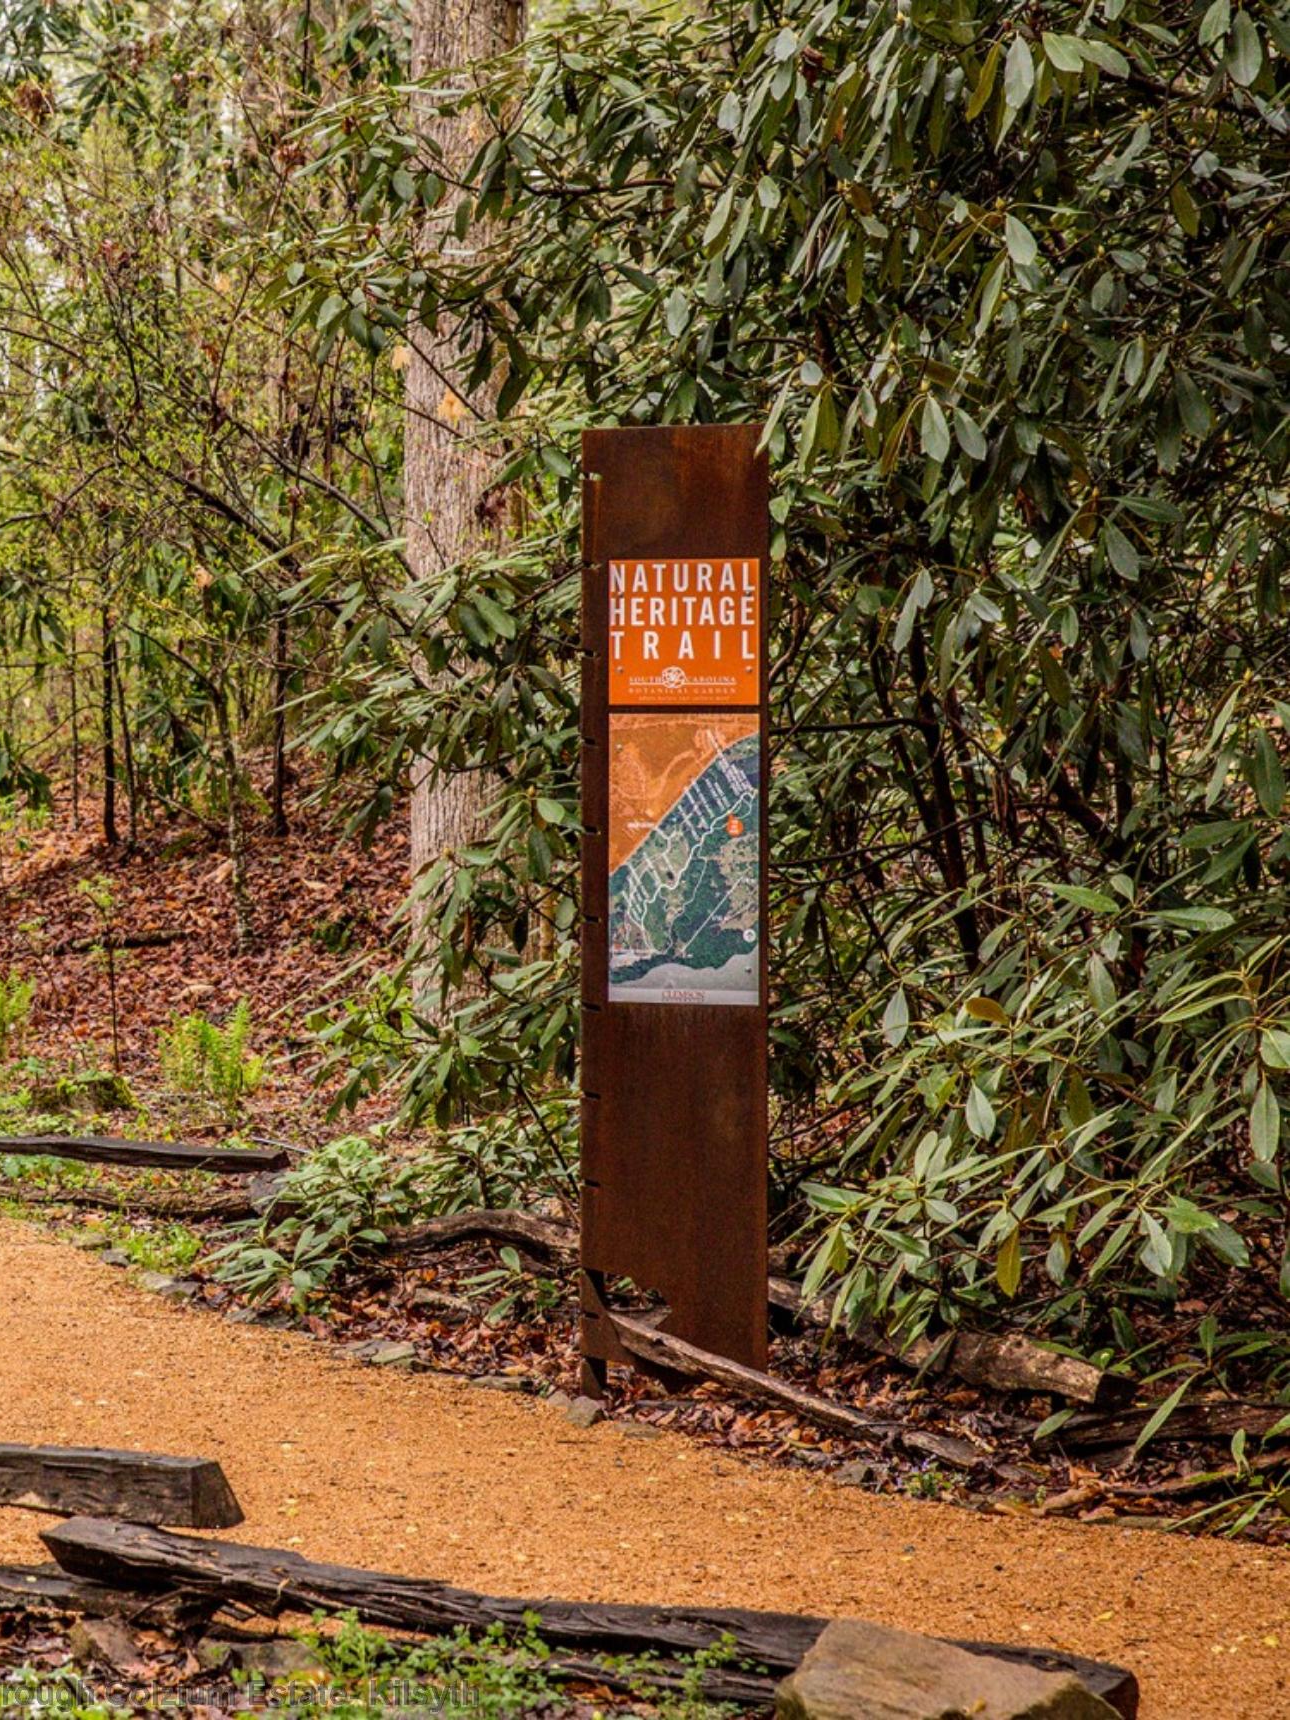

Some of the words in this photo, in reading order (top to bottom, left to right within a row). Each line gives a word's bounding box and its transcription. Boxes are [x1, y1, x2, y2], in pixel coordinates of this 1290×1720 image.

[610, 563, 756, 593] NATURAL
[610, 596, 756, 627] HERITAGE
[610, 630, 756, 660] TRAIL
